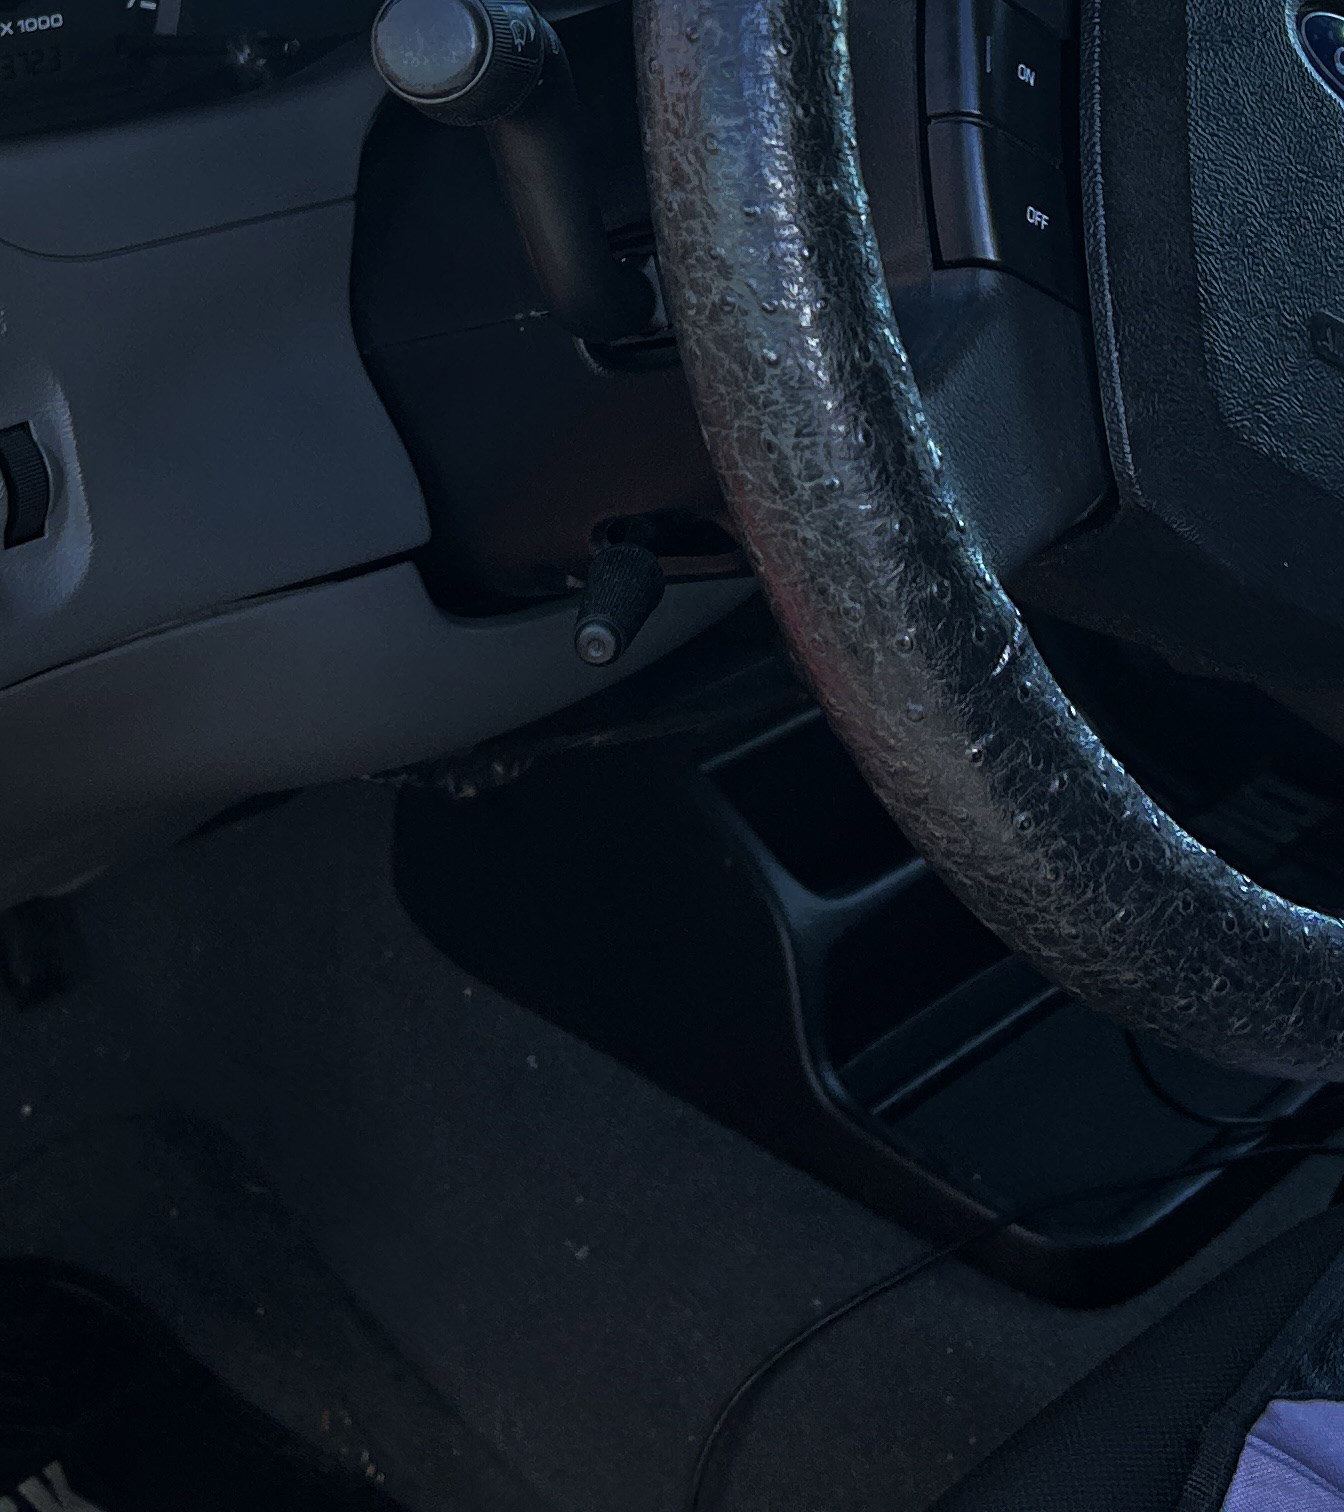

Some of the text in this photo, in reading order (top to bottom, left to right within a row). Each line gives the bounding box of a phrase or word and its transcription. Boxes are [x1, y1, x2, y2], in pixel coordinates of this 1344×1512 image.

[0, 20, 15, 38] X
[16, 13, 65, 34] 1000
[1017, 63, 1036, 87] ON
[1026, 205, 1050, 230] OFF
